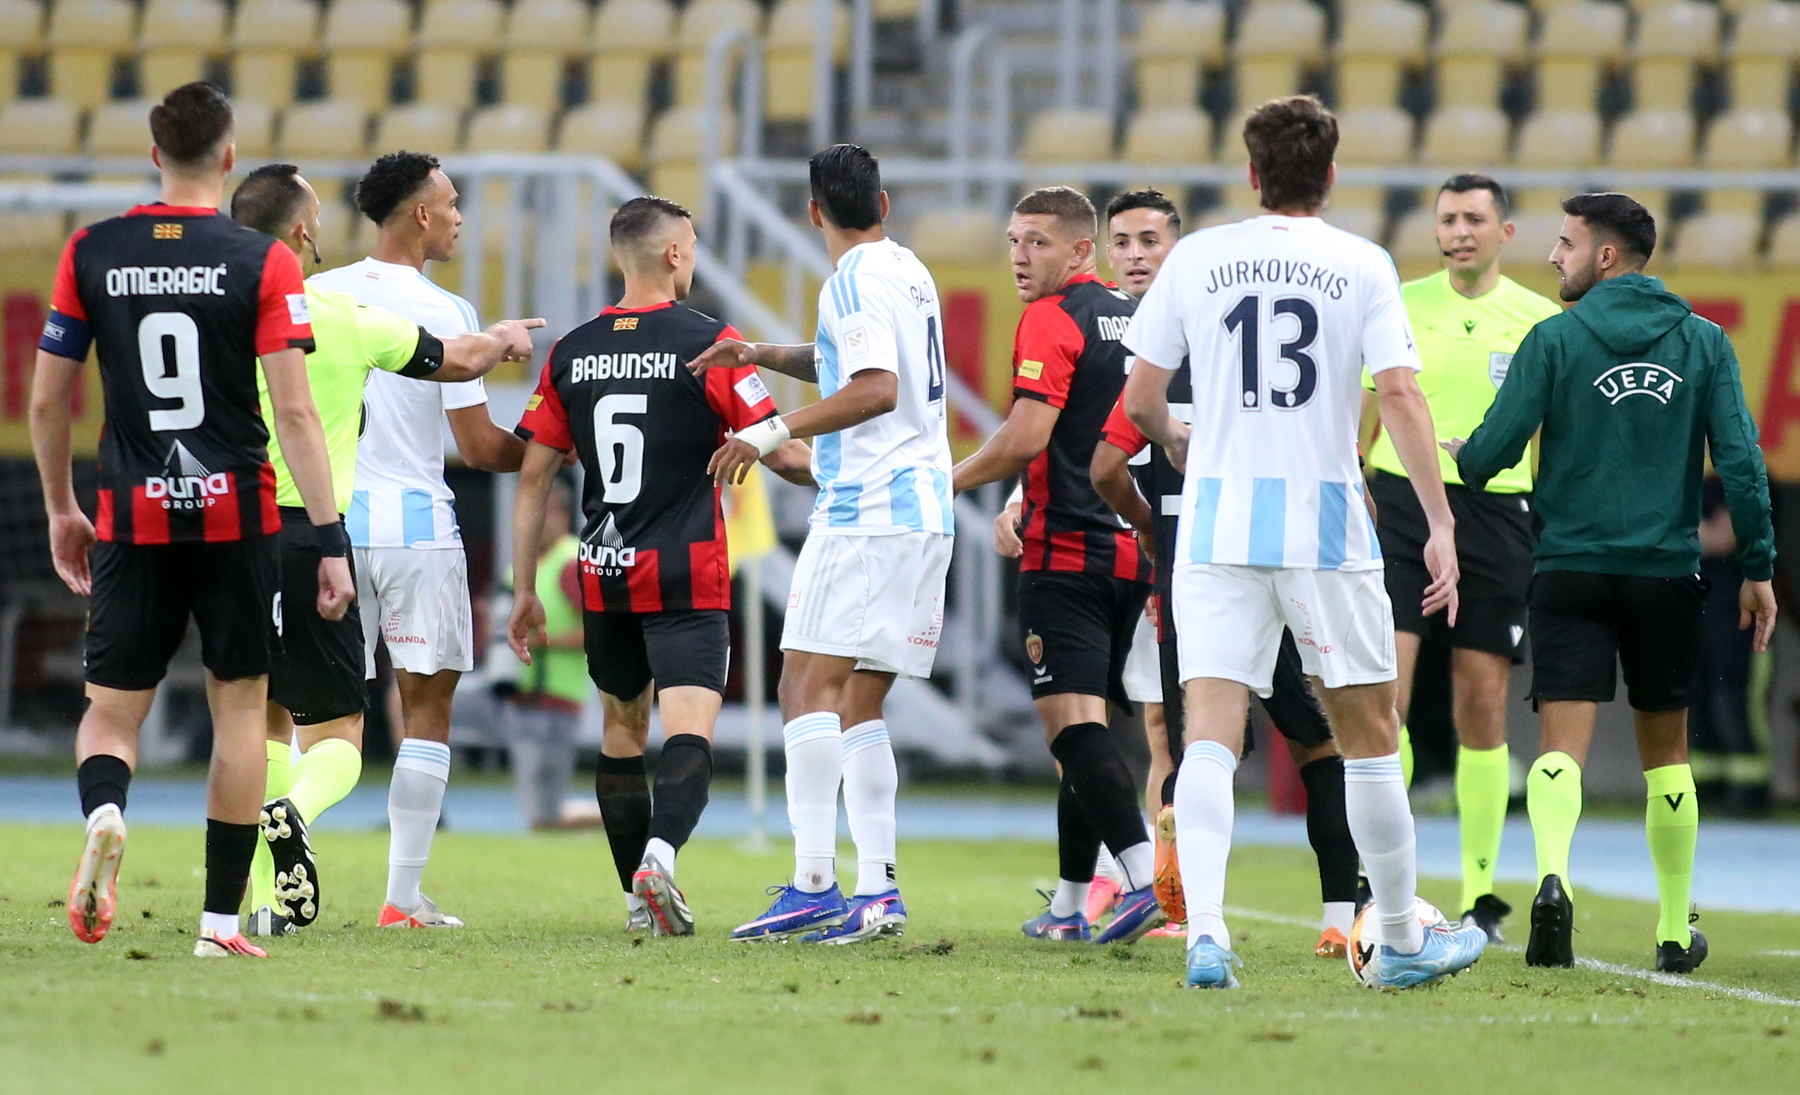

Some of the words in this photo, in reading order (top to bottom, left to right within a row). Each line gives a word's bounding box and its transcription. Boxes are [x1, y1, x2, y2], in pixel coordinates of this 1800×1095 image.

[105, 262, 228, 297] OMERAGIĆ
[1206, 258, 1348, 300] JURKOVSKIS
[571, 352, 677, 384] BABUNSKI
[926, 311, 946, 420] 4
[1220, 291, 1321, 412] 13
[137, 311, 205, 432] 9
[1598, 369, 1675, 400] UEFA
[593, 394, 648, 504] 6
[161, 497, 216, 510] GROUP
[583, 564, 623, 577] GROUP
[383, 634, 427, 644] OMANDA
